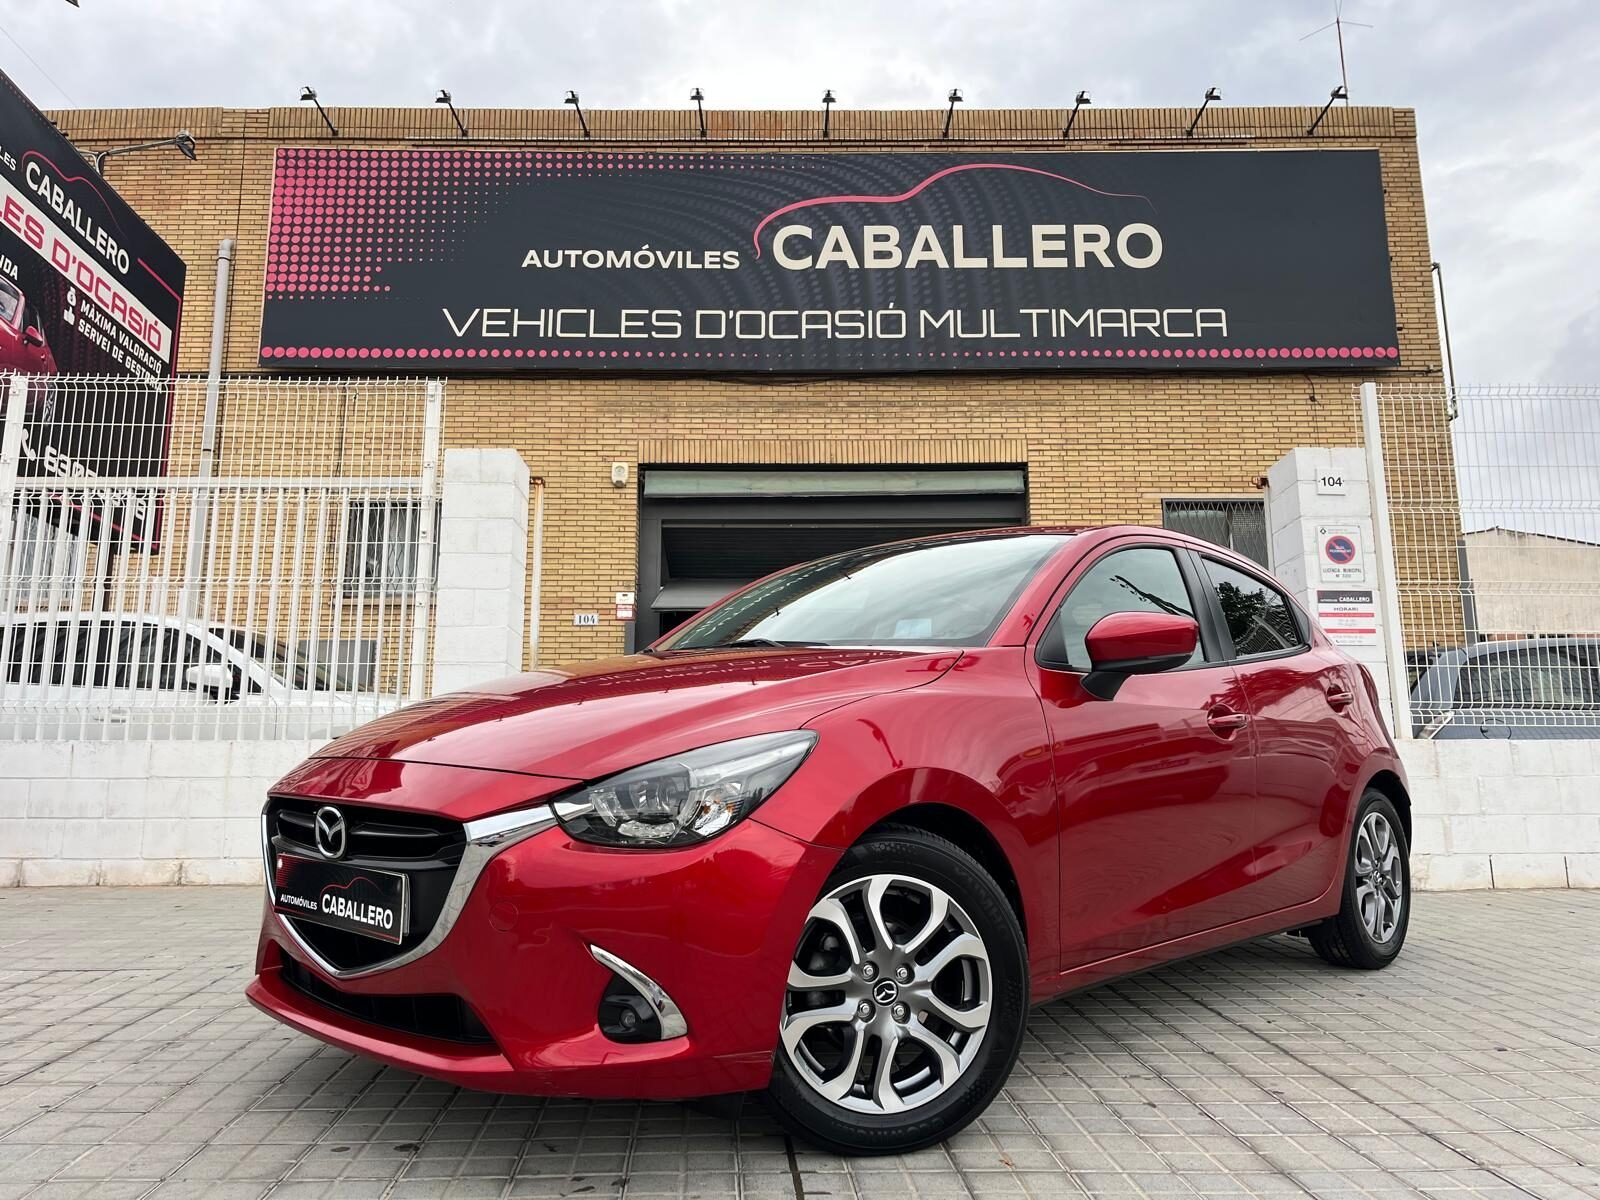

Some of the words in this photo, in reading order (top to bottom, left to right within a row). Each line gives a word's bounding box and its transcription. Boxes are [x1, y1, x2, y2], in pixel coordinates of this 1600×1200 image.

[26, 161, 130, 274] CABALLERO
[521, 244, 740, 269] AUTOMÓVILES
[772, 223, 1163, 271] CABALLERO
[0, 194, 45, 250] ES
[51, 238, 162, 352] D'OCASIÓ
[78, 318, 111, 353] SERVEI
[111, 345, 125, 364] DE
[80, 299, 117, 339] MÀXIMA
[119, 330, 162, 374] VALORACIÓ
[442, 308, 682, 339] VEHICLES
[695, 302, 907, 340] D'OCASIÓ
[920, 308, 1228, 339] MULTIMARCA
[1321, 476, 1343, 487] 104
[578, 615, 595, 624] 104
[280, 893, 318, 911] AUTOMÓVILES
[321, 893, 394, 930] CABALLERO
